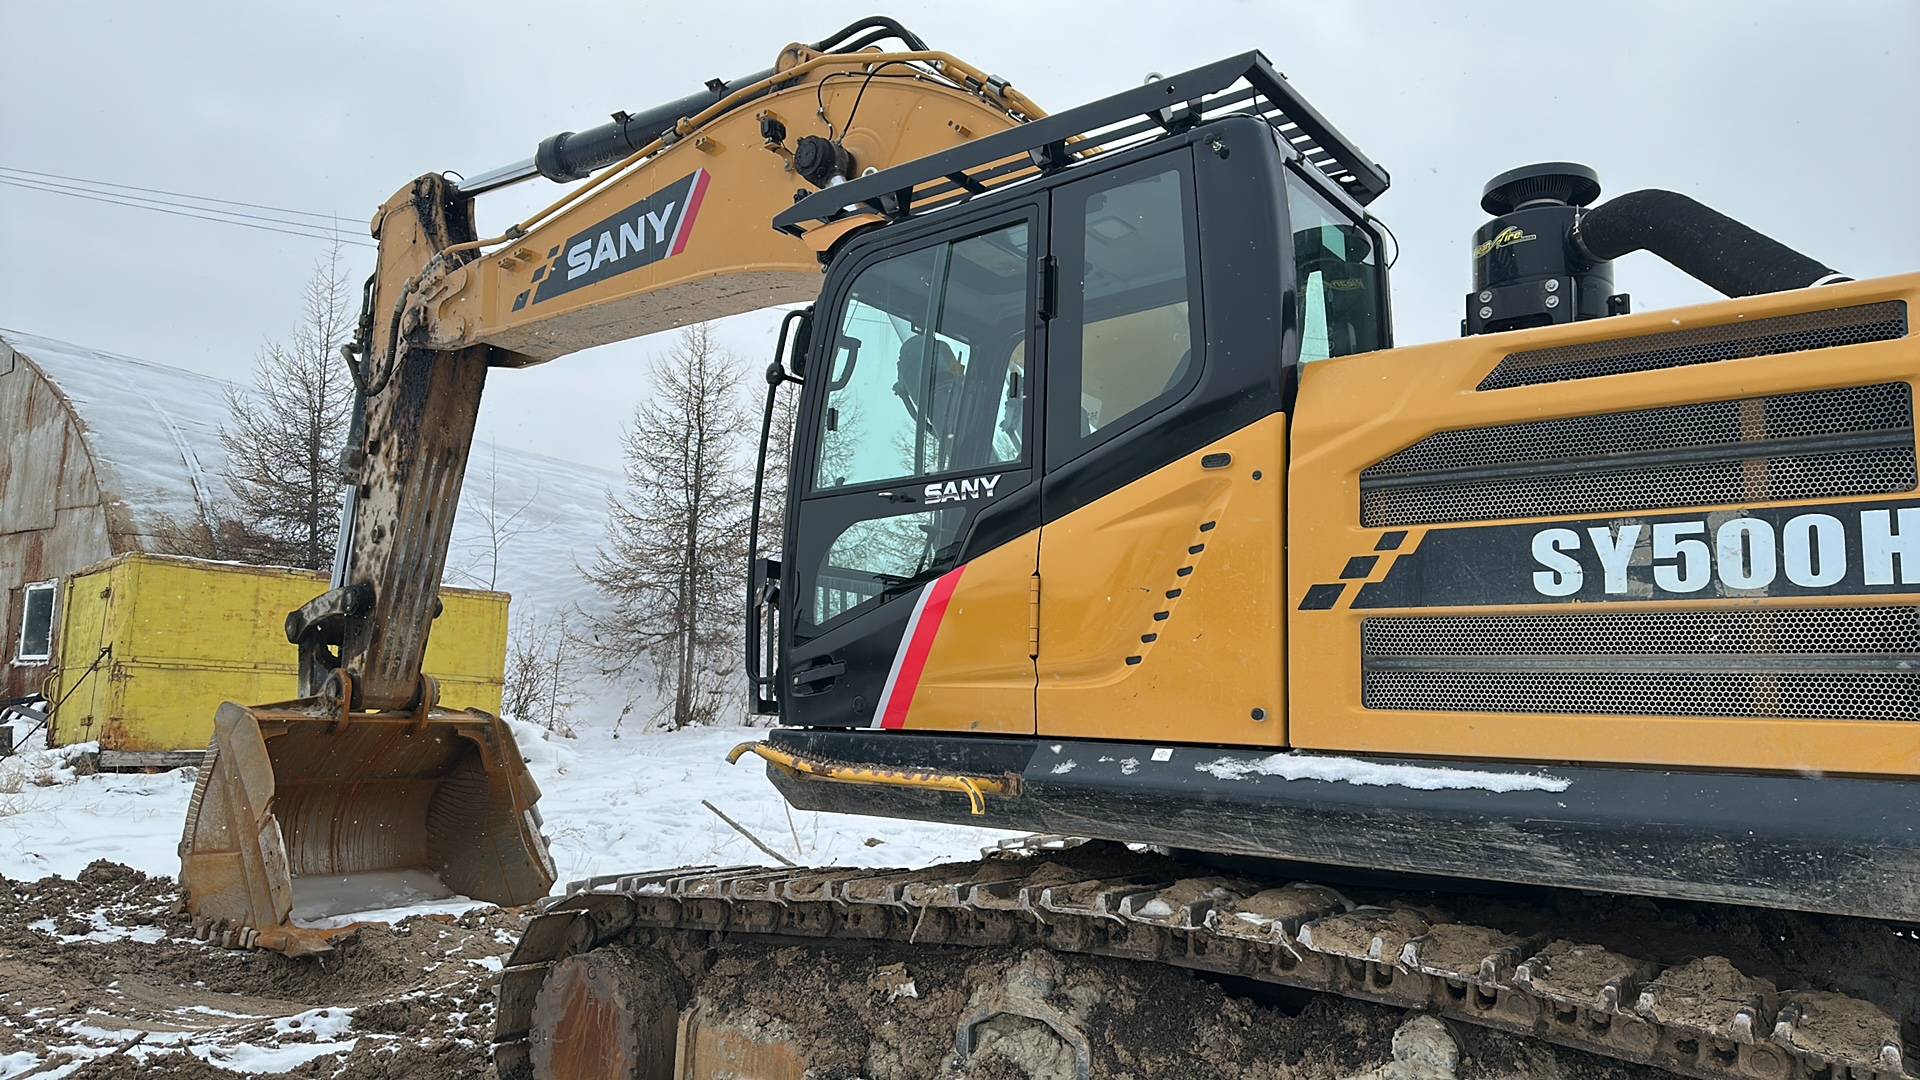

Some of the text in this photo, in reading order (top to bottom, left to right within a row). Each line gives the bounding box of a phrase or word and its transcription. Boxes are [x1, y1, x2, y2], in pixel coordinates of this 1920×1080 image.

[567, 201, 676, 281] SANY
[924, 474, 1002, 505] SANY
[1531, 507, 1920, 597] SY500H
